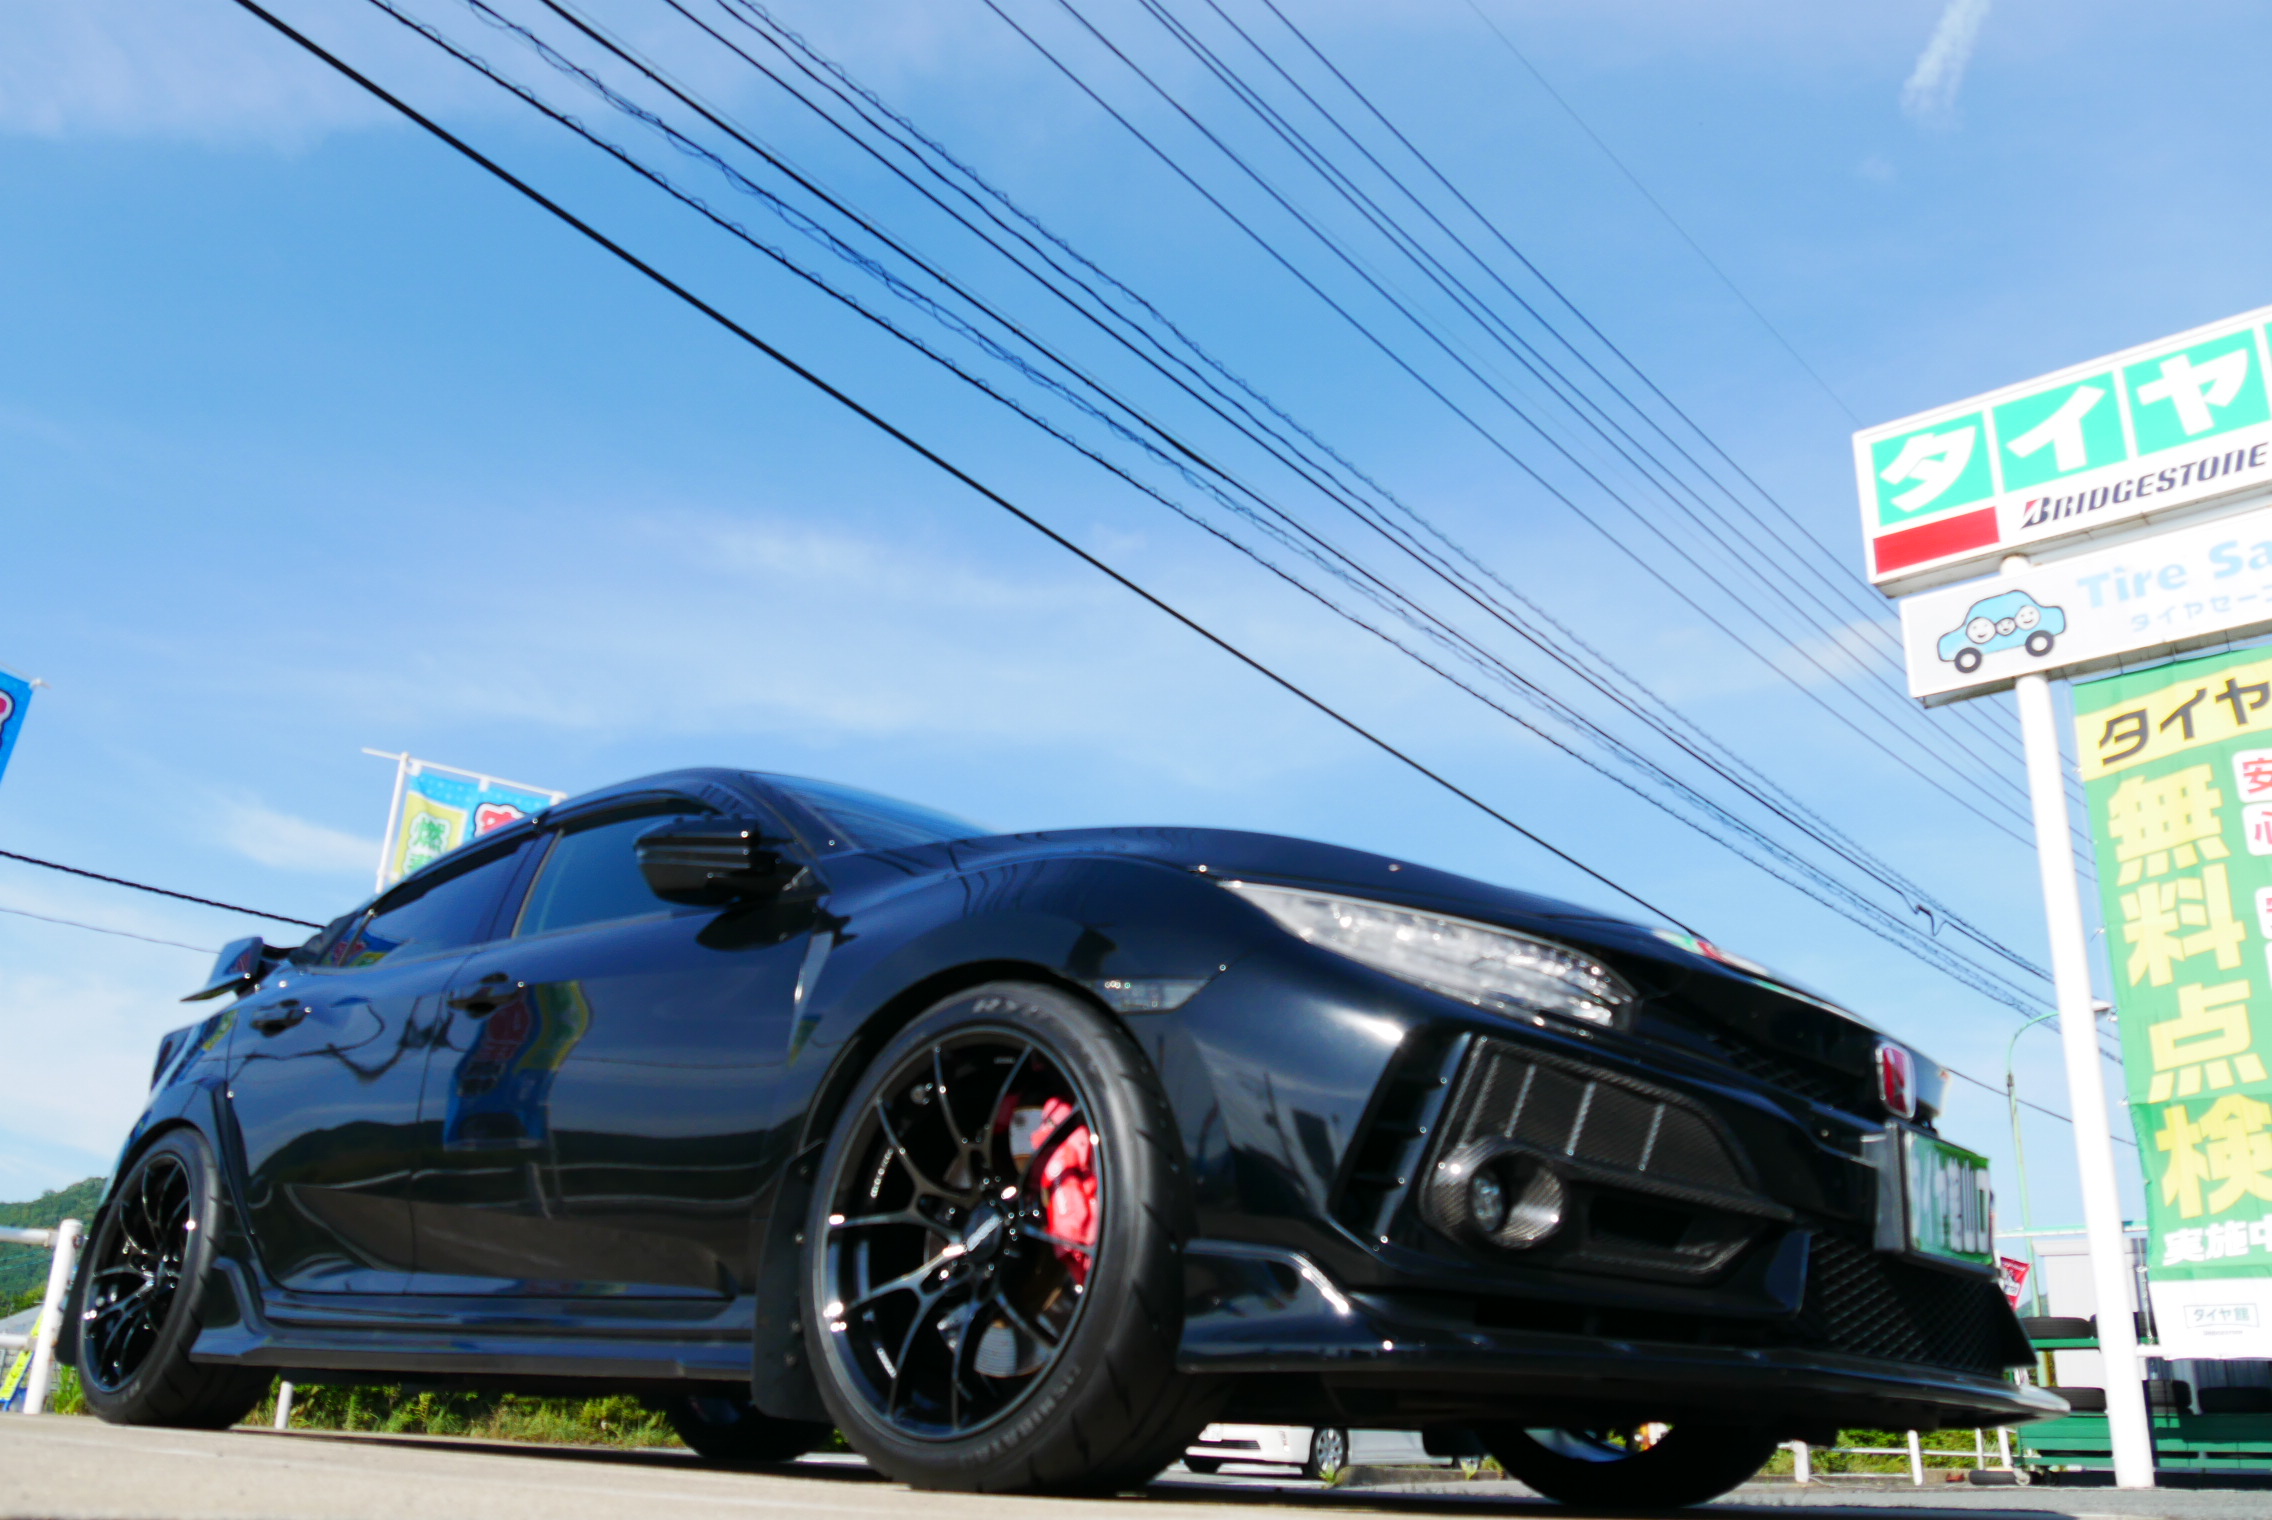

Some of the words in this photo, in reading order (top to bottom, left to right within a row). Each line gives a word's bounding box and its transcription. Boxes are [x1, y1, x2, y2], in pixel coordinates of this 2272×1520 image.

[1879, 348, 2249, 513] タイヤ
[2021, 441, 2270, 530] BRIDGESTONE
[2077, 563, 2188, 609] Tire
[2099, 677, 2271, 767] タイヤ
[2107, 763, 2272, 1220] 無料点検
